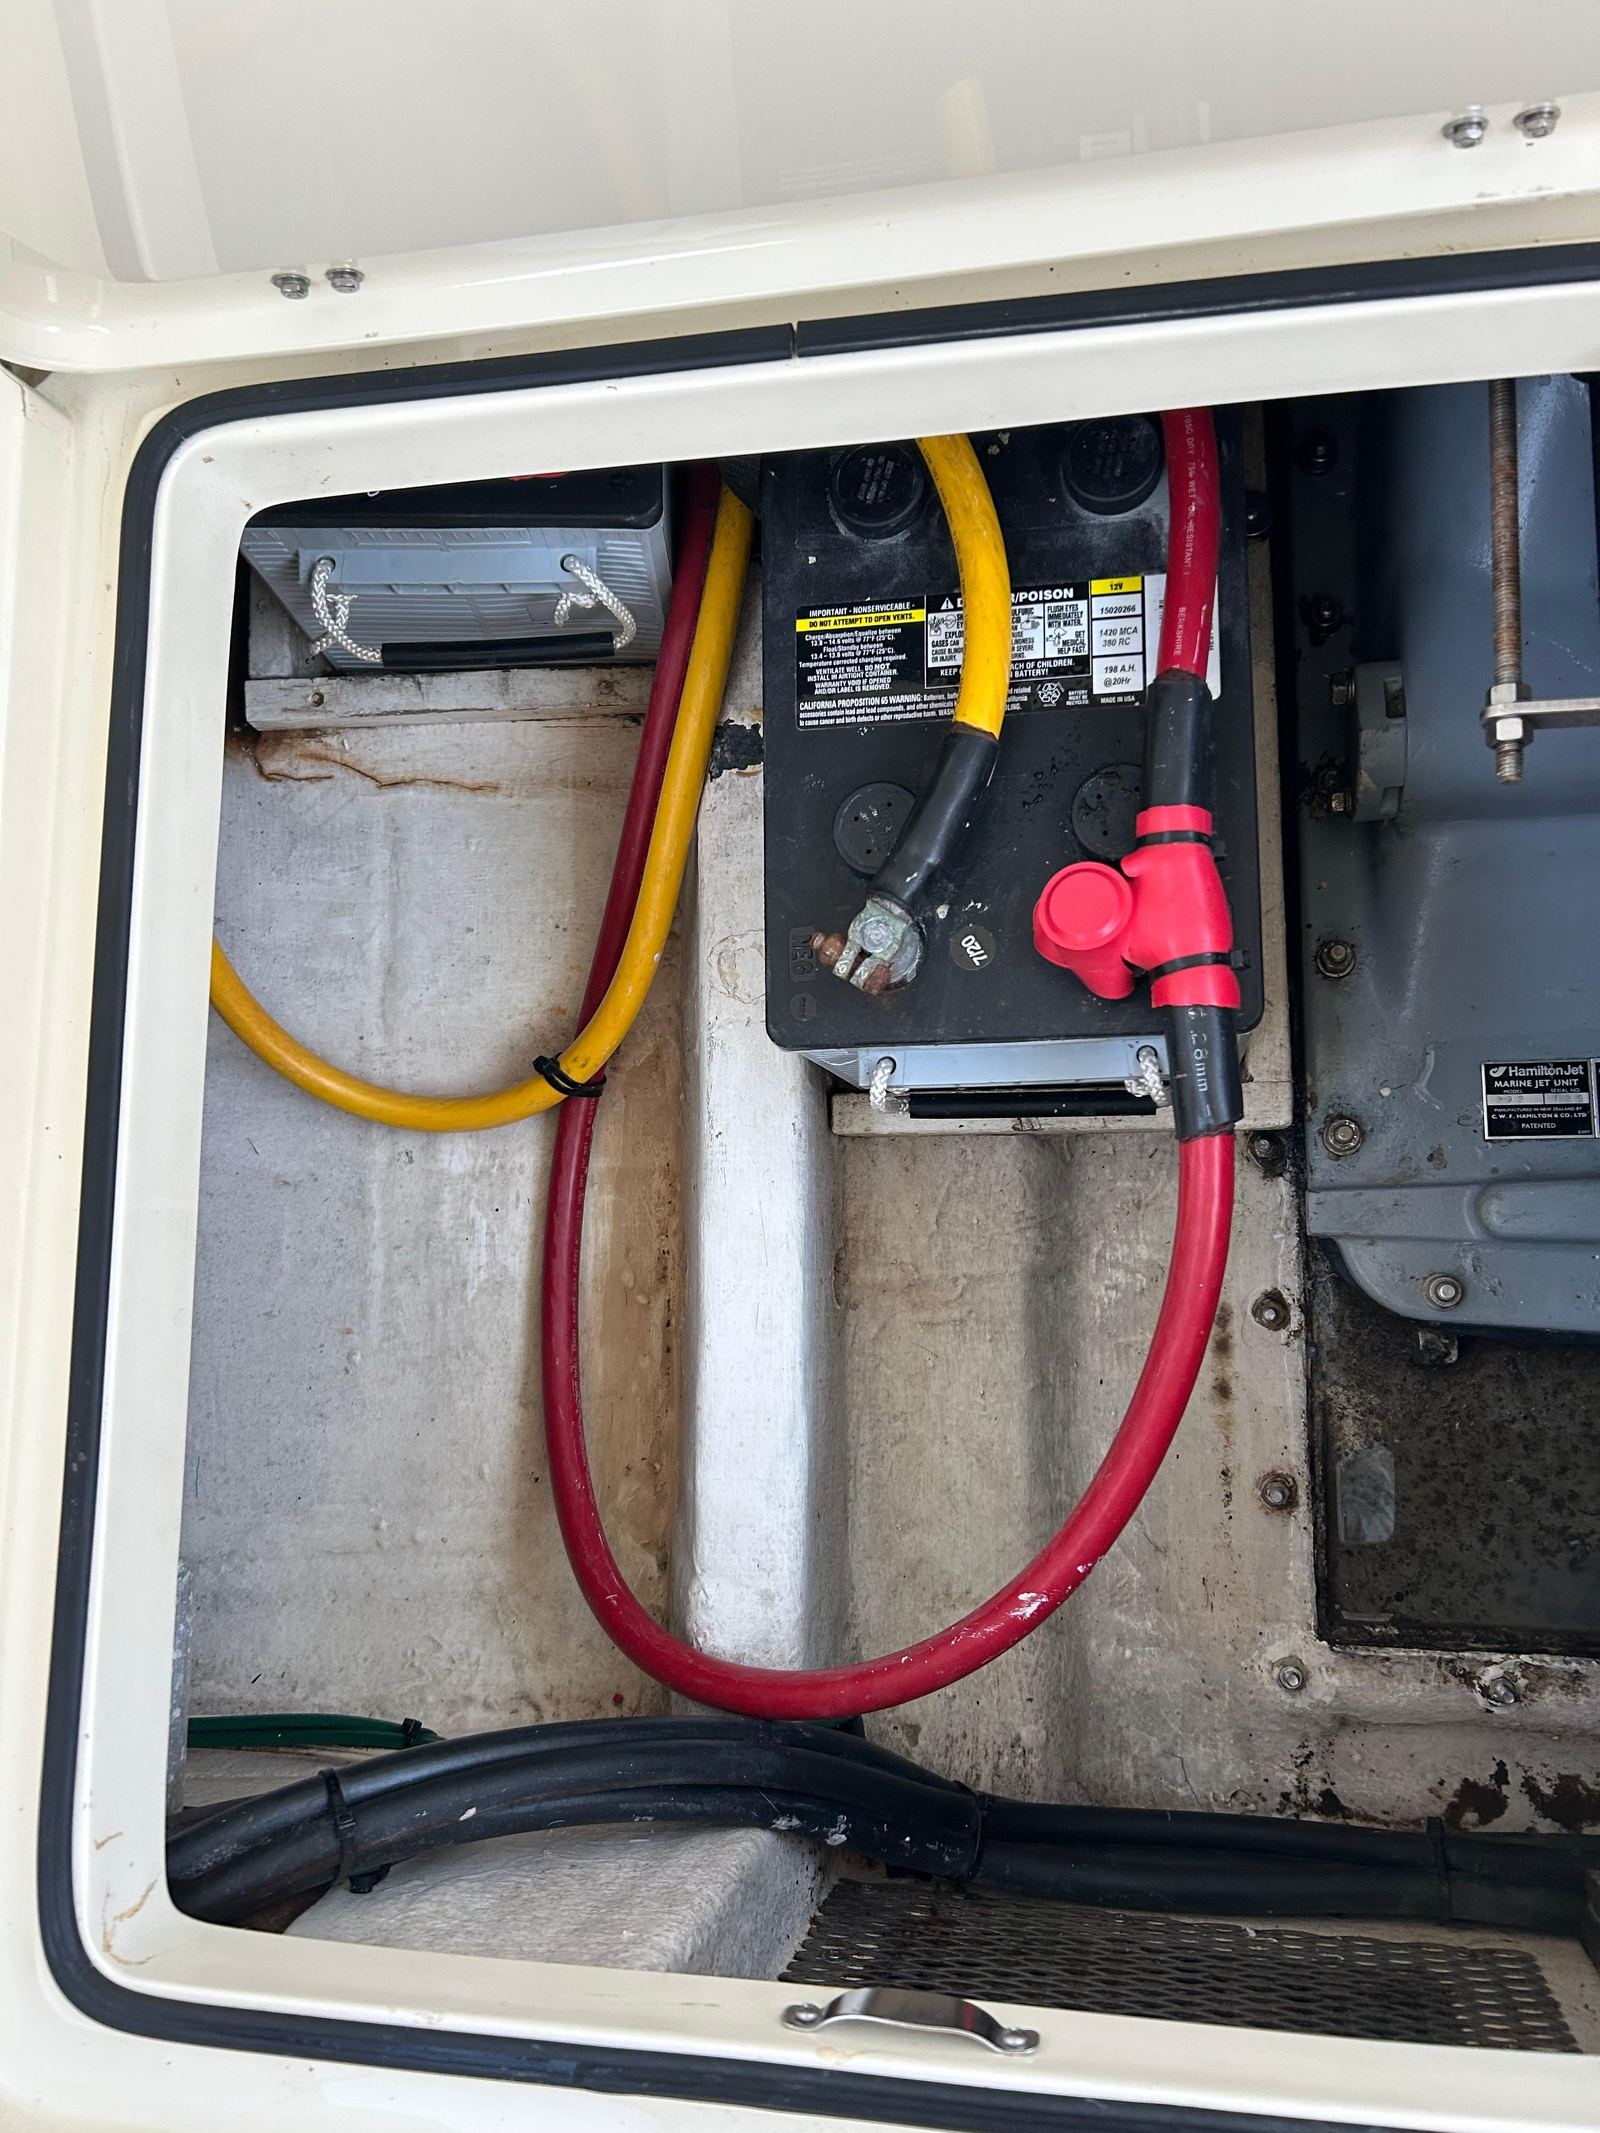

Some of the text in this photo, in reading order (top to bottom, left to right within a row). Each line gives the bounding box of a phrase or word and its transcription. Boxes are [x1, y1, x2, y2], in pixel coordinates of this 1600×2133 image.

[1109, 583, 1124, 591] 12V
[809, 602, 910, 618] IMPORTANT NONSERVICEABLE
[1047, 605, 1064, 614] FLUSH
[1100, 605, 1136, 614] 15020266
[833, 617, 862, 626] ATTEMPT
[874, 614, 891, 622] OPEN
[893, 612, 915, 621] VENTS.
[1047, 611, 1083, 620] IMMEDIATELY
[1100, 626, 1138, 637] 1420 MCA
[1174, 607, 1187, 656] BERKSHIRE
[932, 640, 949, 648] GASES
[1102, 638, 1130, 647] 380 RC
[799, 654, 907, 668] Temperature corrected charging required.
[940, 668, 958, 676] KEEP
[1037, 659, 1075, 668] CHILDREN.
[1104, 664, 1136, 674] 198 A.H.
[865, 669, 899, 678] CONTAINER.
[1014, 669, 1048, 678] BATTERY!
[868, 677, 892, 685] OPENED
[1104, 677, 1131, 688] @20Hr
[862, 683, 892, 691] REMOVED.
[800, 700, 836, 710] CALIFORNIA
[838, 697, 880, 708] PROPOSITION
[881, 696, 888, 704] 65
[889, 693, 923, 704] WARNING:
[800, 710, 826, 719] accessories
[845, 707, 855, 716] lead
[856, 707, 865, 715] and
[877, 704, 905, 714] compounds,
[929, 701, 953, 709] chemicals
[857, 714, 874, 723] defects
[880, 713, 893, 721] other
[893, 711, 922, 720] reproductive
[961, 934, 988, 966] 7/20
[1508, 1064, 1584, 1076] HamiltonJet
[1494, 1080, 1532, 1088] MARINE
[1534, 1079, 1550, 1088] JET
